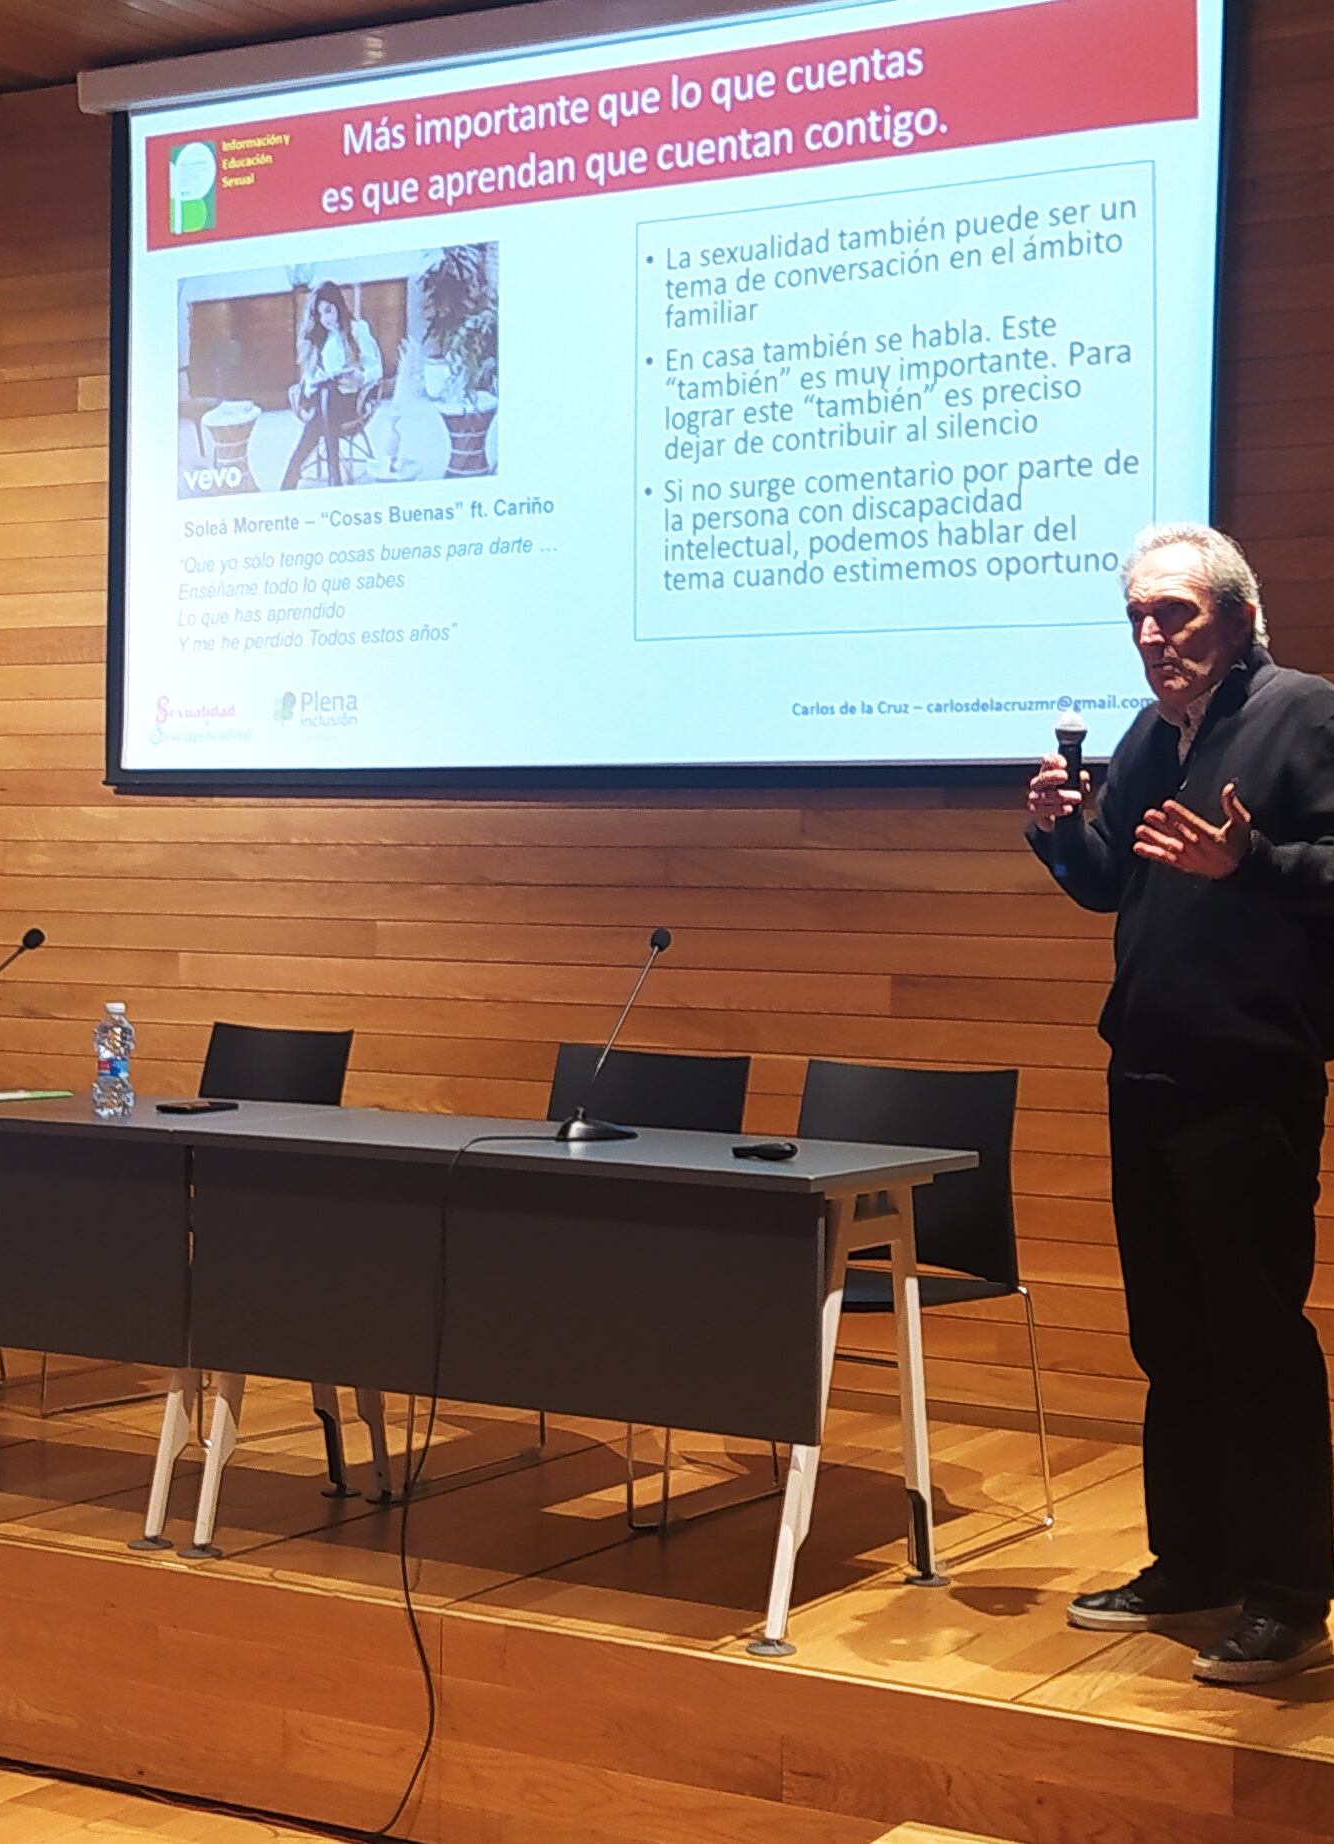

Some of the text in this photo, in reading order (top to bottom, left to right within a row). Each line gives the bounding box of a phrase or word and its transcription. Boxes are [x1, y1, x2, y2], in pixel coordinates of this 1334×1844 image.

[343, 44, 925, 157] Más importante que lo que cuentas
[222, 153, 273, 170] Educación
[321, 103, 949, 215] es que aprendan que cuentan contigo.
[222, 173, 255, 188] Sexual
[667, 200, 1136, 270] La sexualidad también puede ser un
[666, 230, 1123, 300] tema de conversación en el ámbito
[666, 301, 759, 329] familiar
[667, 314, 1057, 372] En casa también se habla. Este
[666, 341, 1132, 401] “también” es muy importante. Para
[665, 375, 1082, 435] lograr este “también” es preciso
[665, 409, 1038, 464] dejar de contribuir al silencio
[664, 448, 1140, 503] Si no surge comentario por parte de
[184, 518, 228, 538] Soleá
[234, 515, 299, 534] Morente
[320, 510, 383, 527] “Cosas
[470, 501, 488, 518] ft.
[493, 496, 555, 517] Cariño
[664, 486, 1022, 536] la persona con discapacidad
[220, 558, 238, 575] yo
[243, 552, 275, 570] sólo
[280, 551, 324, 570] tengo
[329, 548, 375, 564] cosas
[380, 544, 442, 561] buenas
[446, 542, 483, 562] para
[489, 537, 533, 555] darte
[664, 514, 1077, 562] intelectual, podemos hablar del
[178, 572, 405, 600] Enséñame todo lo que sabes
[664, 568, 724, 591] tema
[733, 560, 824, 588] cuando
[833, 556, 977, 583] estimemos
[178, 601, 346, 628] Lo que has aprendido
[179, 636, 190, 651] Y
[193, 639, 215, 652] me
[220, 635, 240, 650] he
[244, 632, 303, 653] perdido
[310, 628, 356, 647] Todos
[361, 627, 405, 643] estos
[300, 713, 358, 728] inclusión
[301, 690, 359, 712] Plena
[792, 701, 836, 717] Carlos
[839, 701, 857, 716] de
[861, 701, 874, 715] la
[877, 701, 910, 715] Cruz
